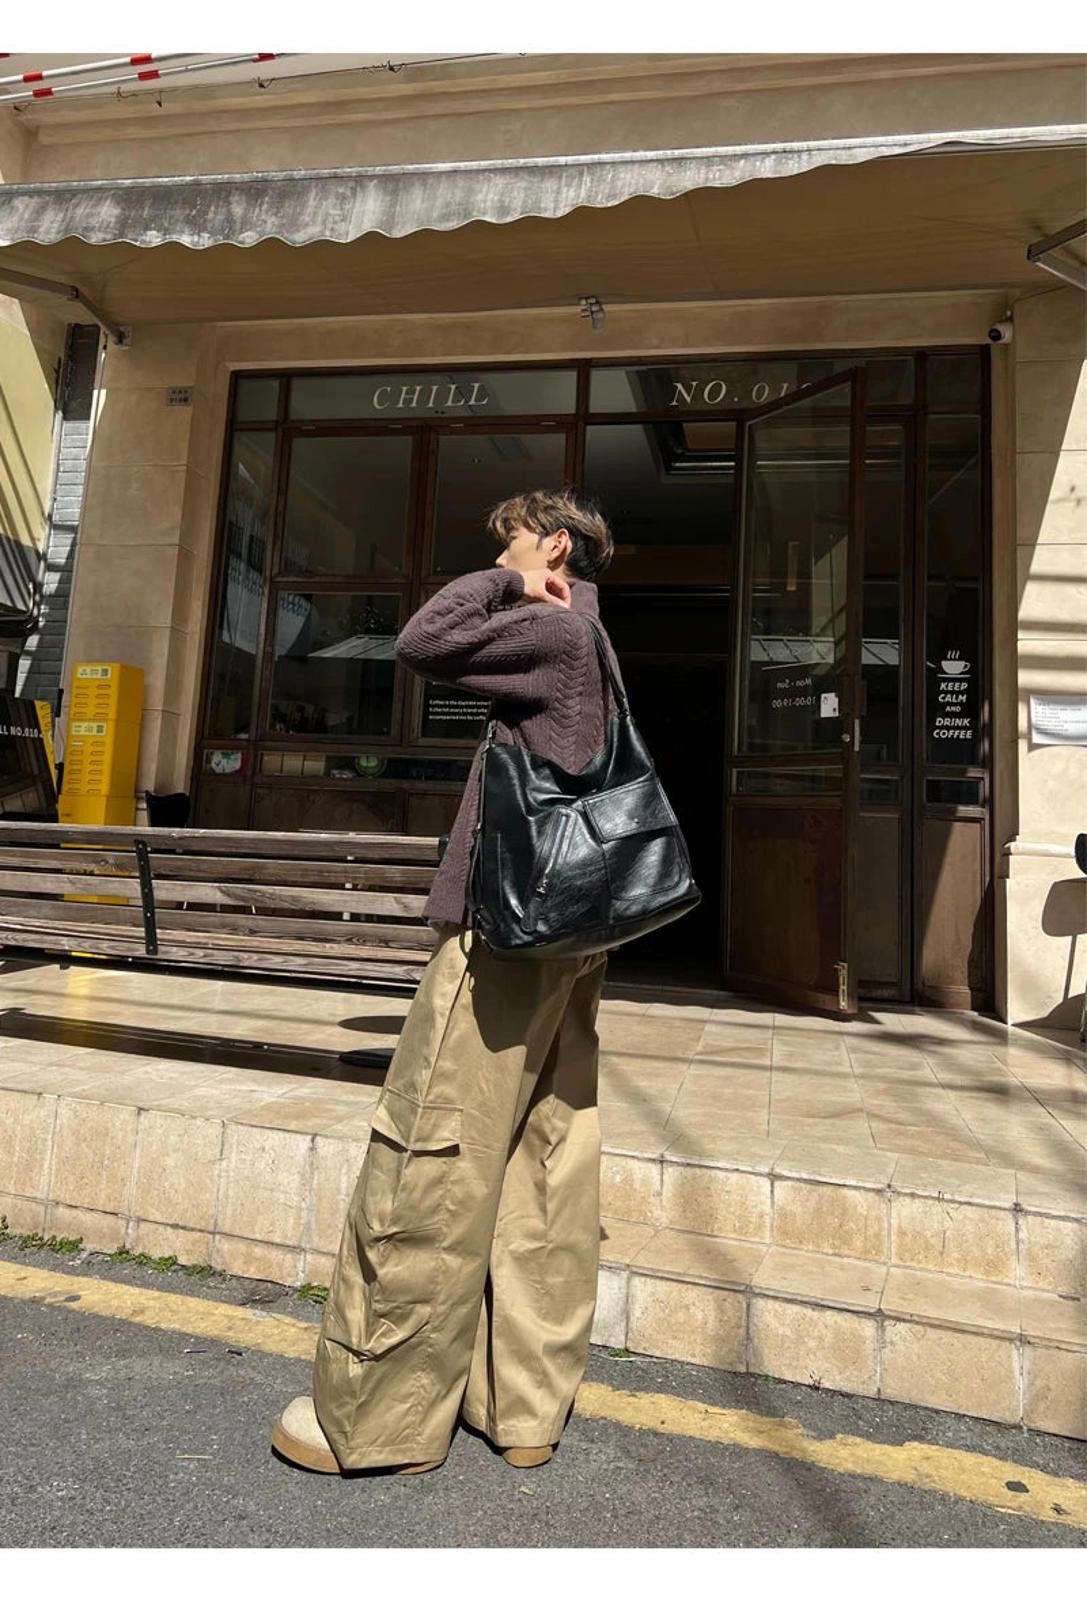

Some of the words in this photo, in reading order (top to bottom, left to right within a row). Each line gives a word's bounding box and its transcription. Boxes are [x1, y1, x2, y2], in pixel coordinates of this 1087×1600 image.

[373, 382, 489, 409] CHILL
[669, 380, 812, 406] NO.01
[940, 681, 968, 691] KEEP
[938, 693, 967, 703] CALM
[935, 717, 971, 727] DRINK
[932, 729, 973, 739] COFFEE
